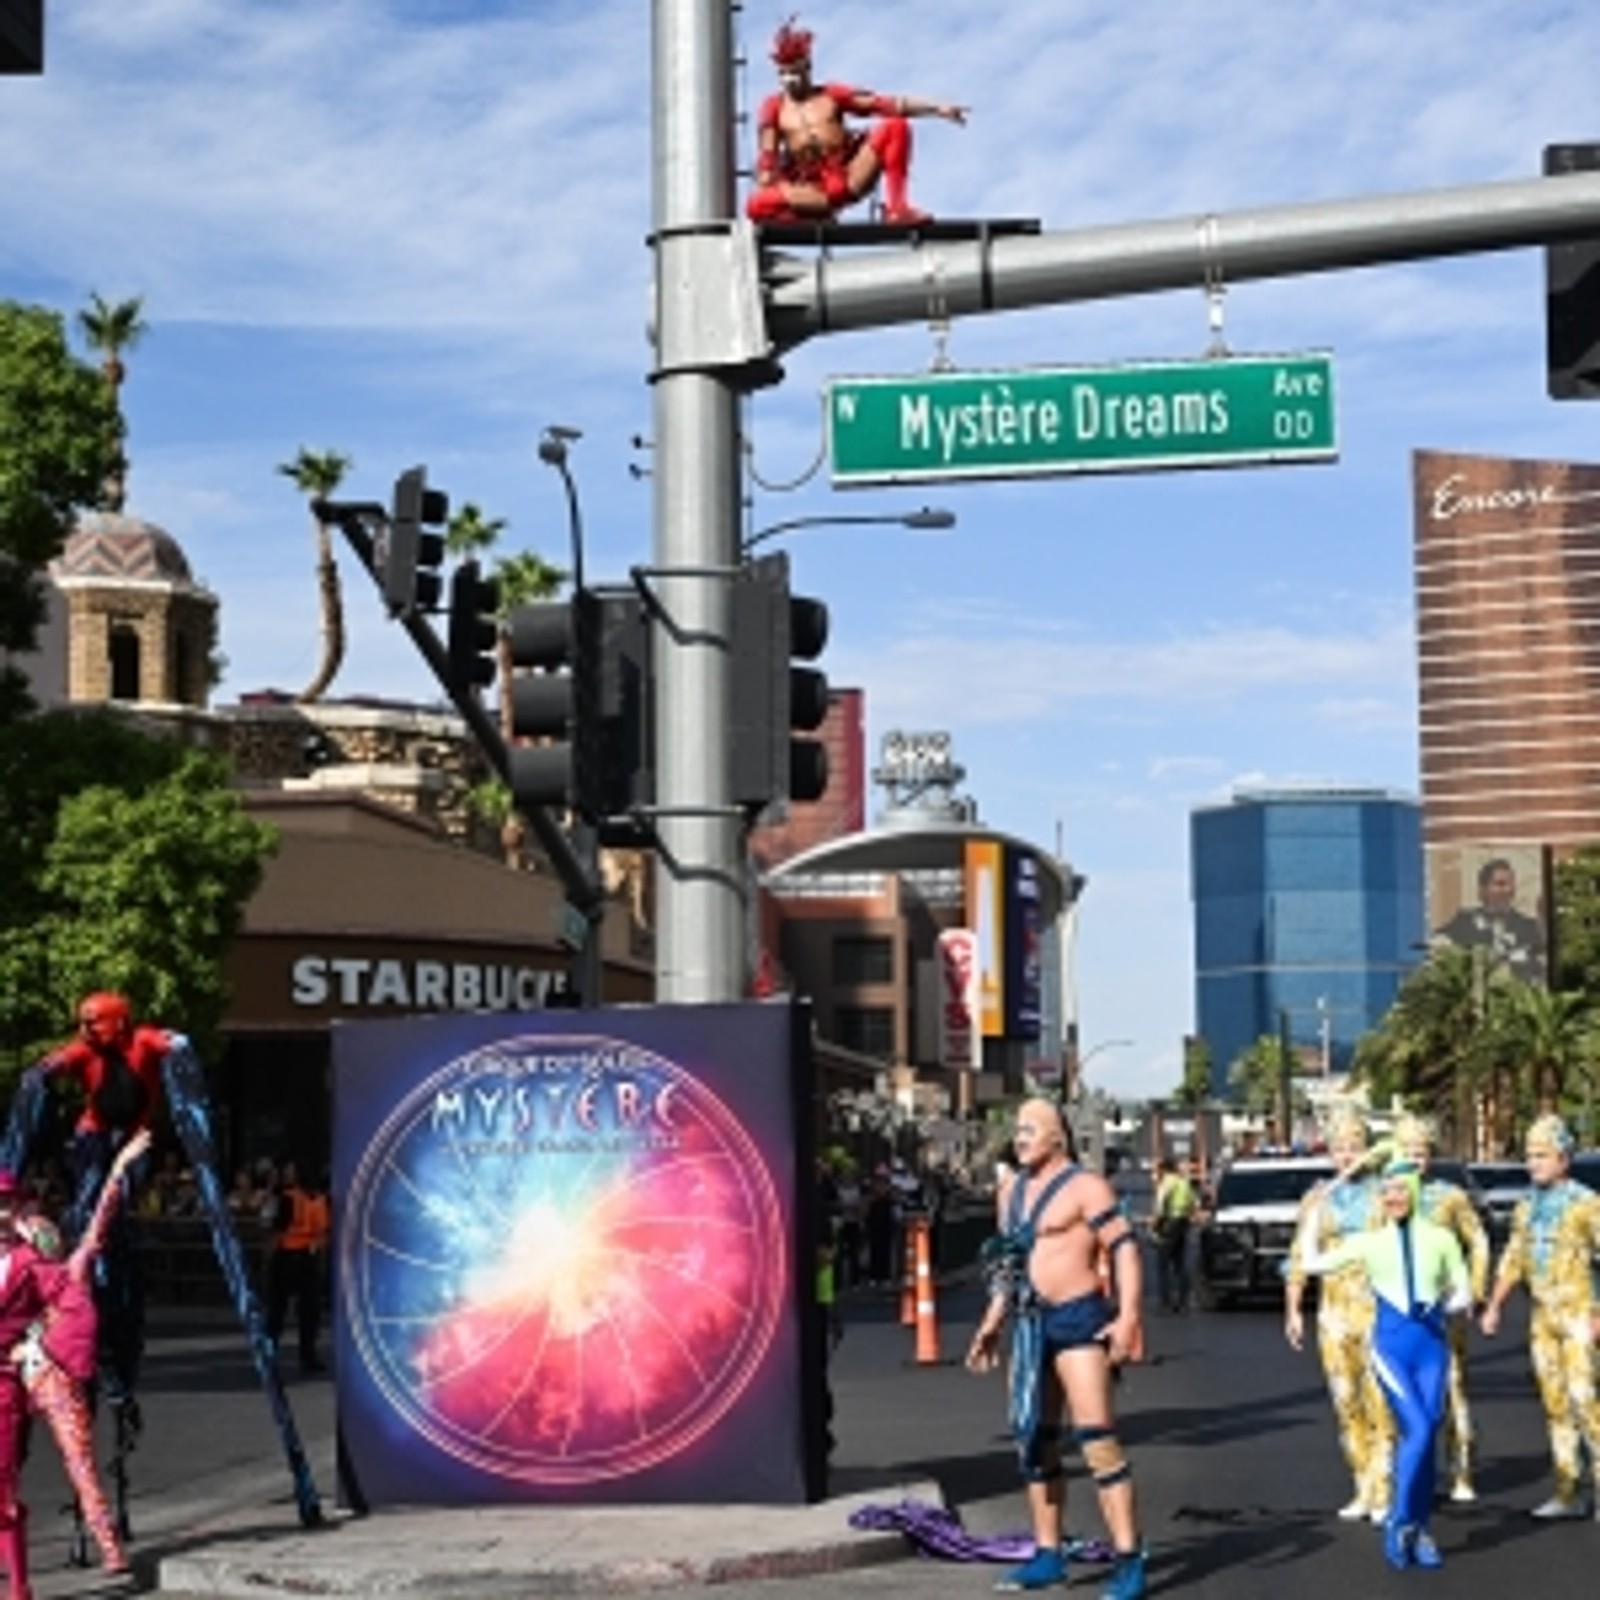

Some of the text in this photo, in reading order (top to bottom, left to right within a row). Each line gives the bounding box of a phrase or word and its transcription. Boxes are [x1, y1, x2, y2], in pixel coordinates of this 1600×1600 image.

[901, 385, 1059, 462] Mystère
[1073, 385, 1230, 442] Dreams
[1274, 368, 1324, 397] Ave
[1431, 472, 1556, 520] Encore
